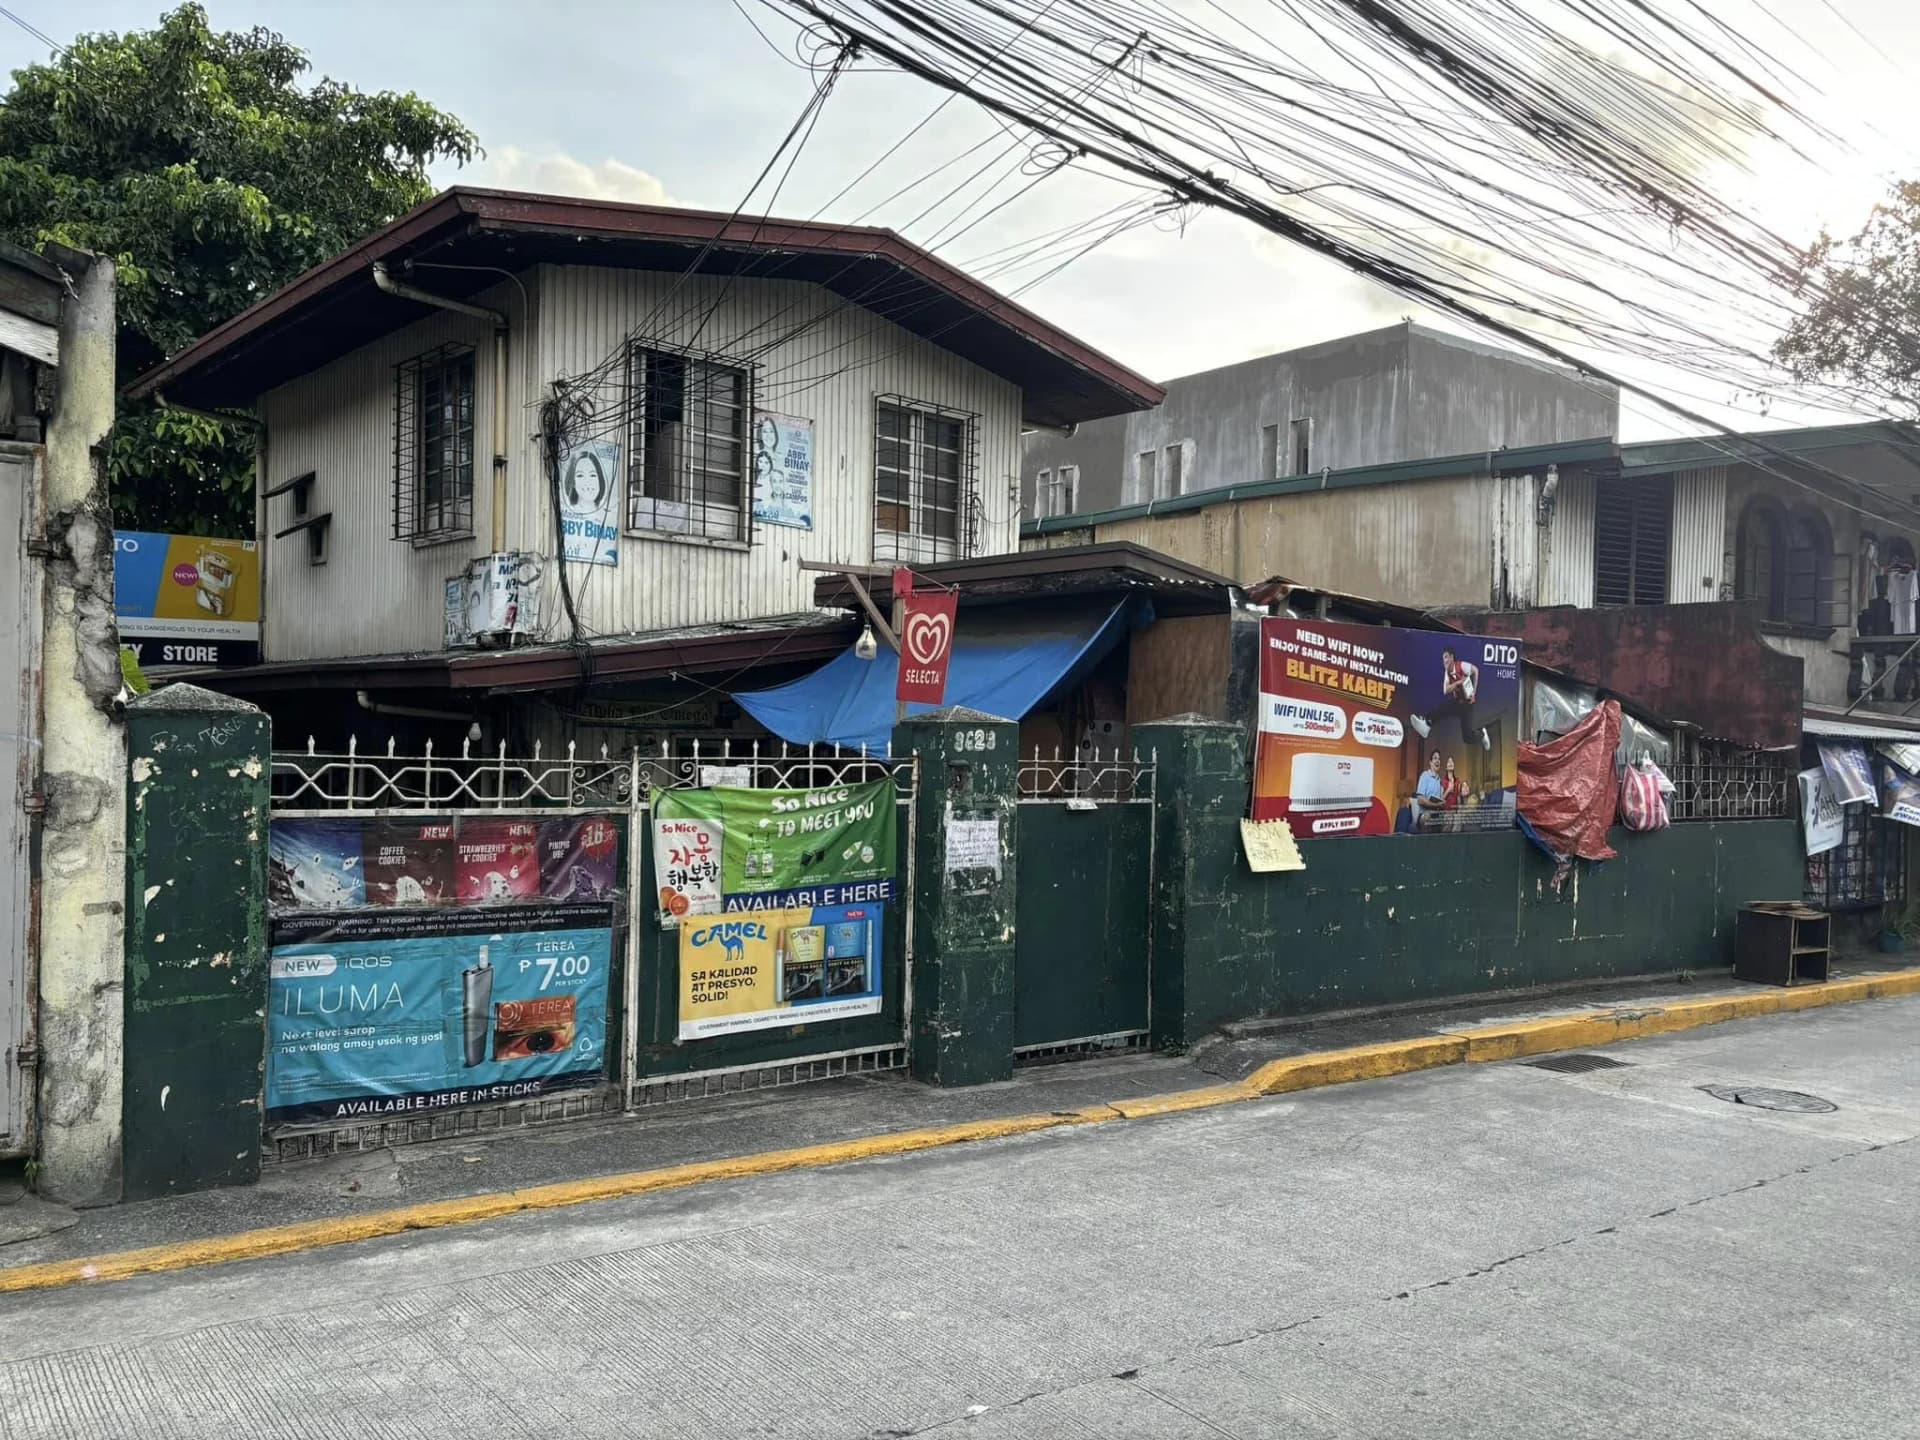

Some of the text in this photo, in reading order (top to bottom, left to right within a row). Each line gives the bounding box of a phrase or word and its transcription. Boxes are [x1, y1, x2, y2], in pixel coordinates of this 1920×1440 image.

[561, 520, 583, 536] BBY
[163, 645, 218, 662] STORE
[1296, 629, 1384, 664] NEED WIFI NOW?
[1484, 643, 1518, 664] DITO
[1270, 637, 1409, 685] ENJOY SAME-DAY INSTALLATION
[905, 669, 940, 684] SELECTA
[1286, 658, 1396, 702] BLITZ KABIT
[1496, 668, 1516, 680] HOME
[1274, 702, 1334, 723] WIFI UNLI 5G
[1304, 721, 1335, 734] 500mbps
[510, 825, 533, 836] NEW
[662, 824, 698, 833] So Nice
[777, 819, 796, 838] TO
[800, 810, 841, 834] MEET
[1320, 821, 1338, 829] APPLY
[424, 826, 449, 838] NEW
[380, 846, 404, 856] COFFEE
[458, 844, 506, 854] STRAWBERRIES
[378, 856, 406, 865] COOKIES
[472, 853, 498, 862] COOKIES
[842, 882, 890, 903] HERE
[691, 922, 768, 947] CAMEL
[536, 941, 576, 952] TEREA
[285, 960, 320, 972] NEW
[691, 966, 758, 982] SA KALIDAD
[691, 978, 756, 992] AT PRESYO,
[284, 982, 404, 1016] ILUMA
[692, 991, 728, 1004] SOLID!
[530, 999, 572, 1015] TEREA
[282, 1026, 376, 1041] Next level sarap
[281, 1031, 443, 1054] na walang amoy usok ng yosi
[336, 1081, 541, 1117] AVAILABLE HERE IN STICKS
